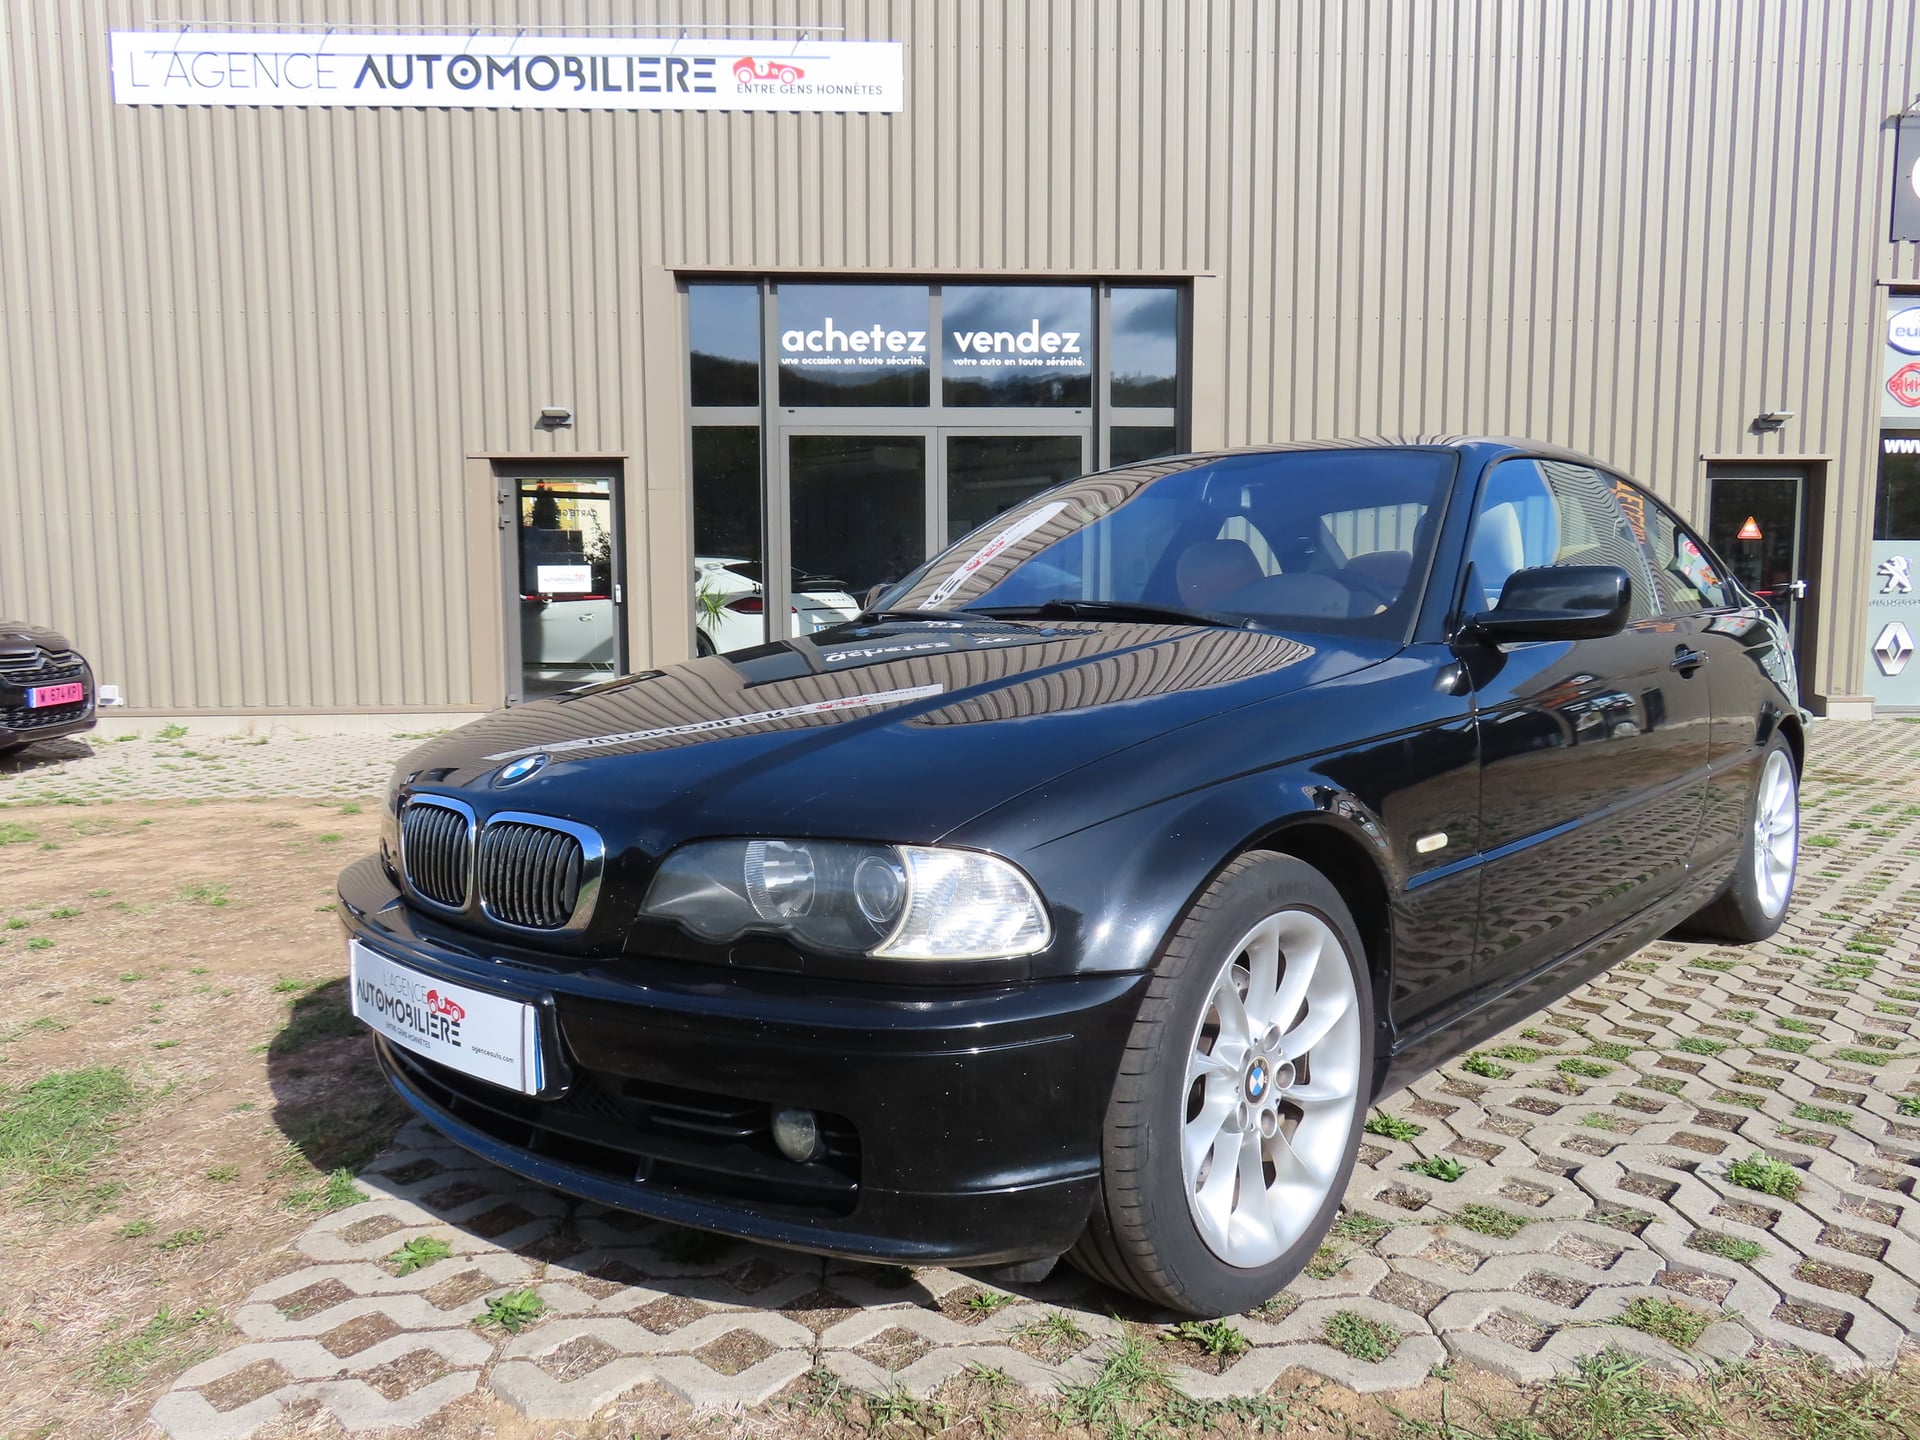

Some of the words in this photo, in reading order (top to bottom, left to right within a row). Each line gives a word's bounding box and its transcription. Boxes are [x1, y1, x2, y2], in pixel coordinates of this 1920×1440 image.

[130, 51, 337, 89] L'AGENCE
[353, 53, 716, 93] AUTOMOBILIERE
[737, 84, 776, 95] ENTRE
[780, 84, 813, 95] GENS
[817, 82, 883, 95] HONNÊTES
[782, 317, 926, 352] achetez
[953, 319, 1081, 353] vendez
[1895, 327, 1920, 337] eu
[782, 357, 800, 365] une
[802, 355, 841, 365] occasion
[844, 357, 856, 365] en
[858, 356, 884, 365] toute
[886, 355, 926, 366] sécurité.
[953, 358, 978, 366] votre
[980, 357, 1002, 366] auto
[1004, 358, 1016, 366] en
[1018, 357, 1043, 366] toute
[1046, 356, 1085, 367] sérénité.
[383, 970, 428, 1004] L'AGENCE
[357, 977, 462, 1047] AUTOMOBILIERE
